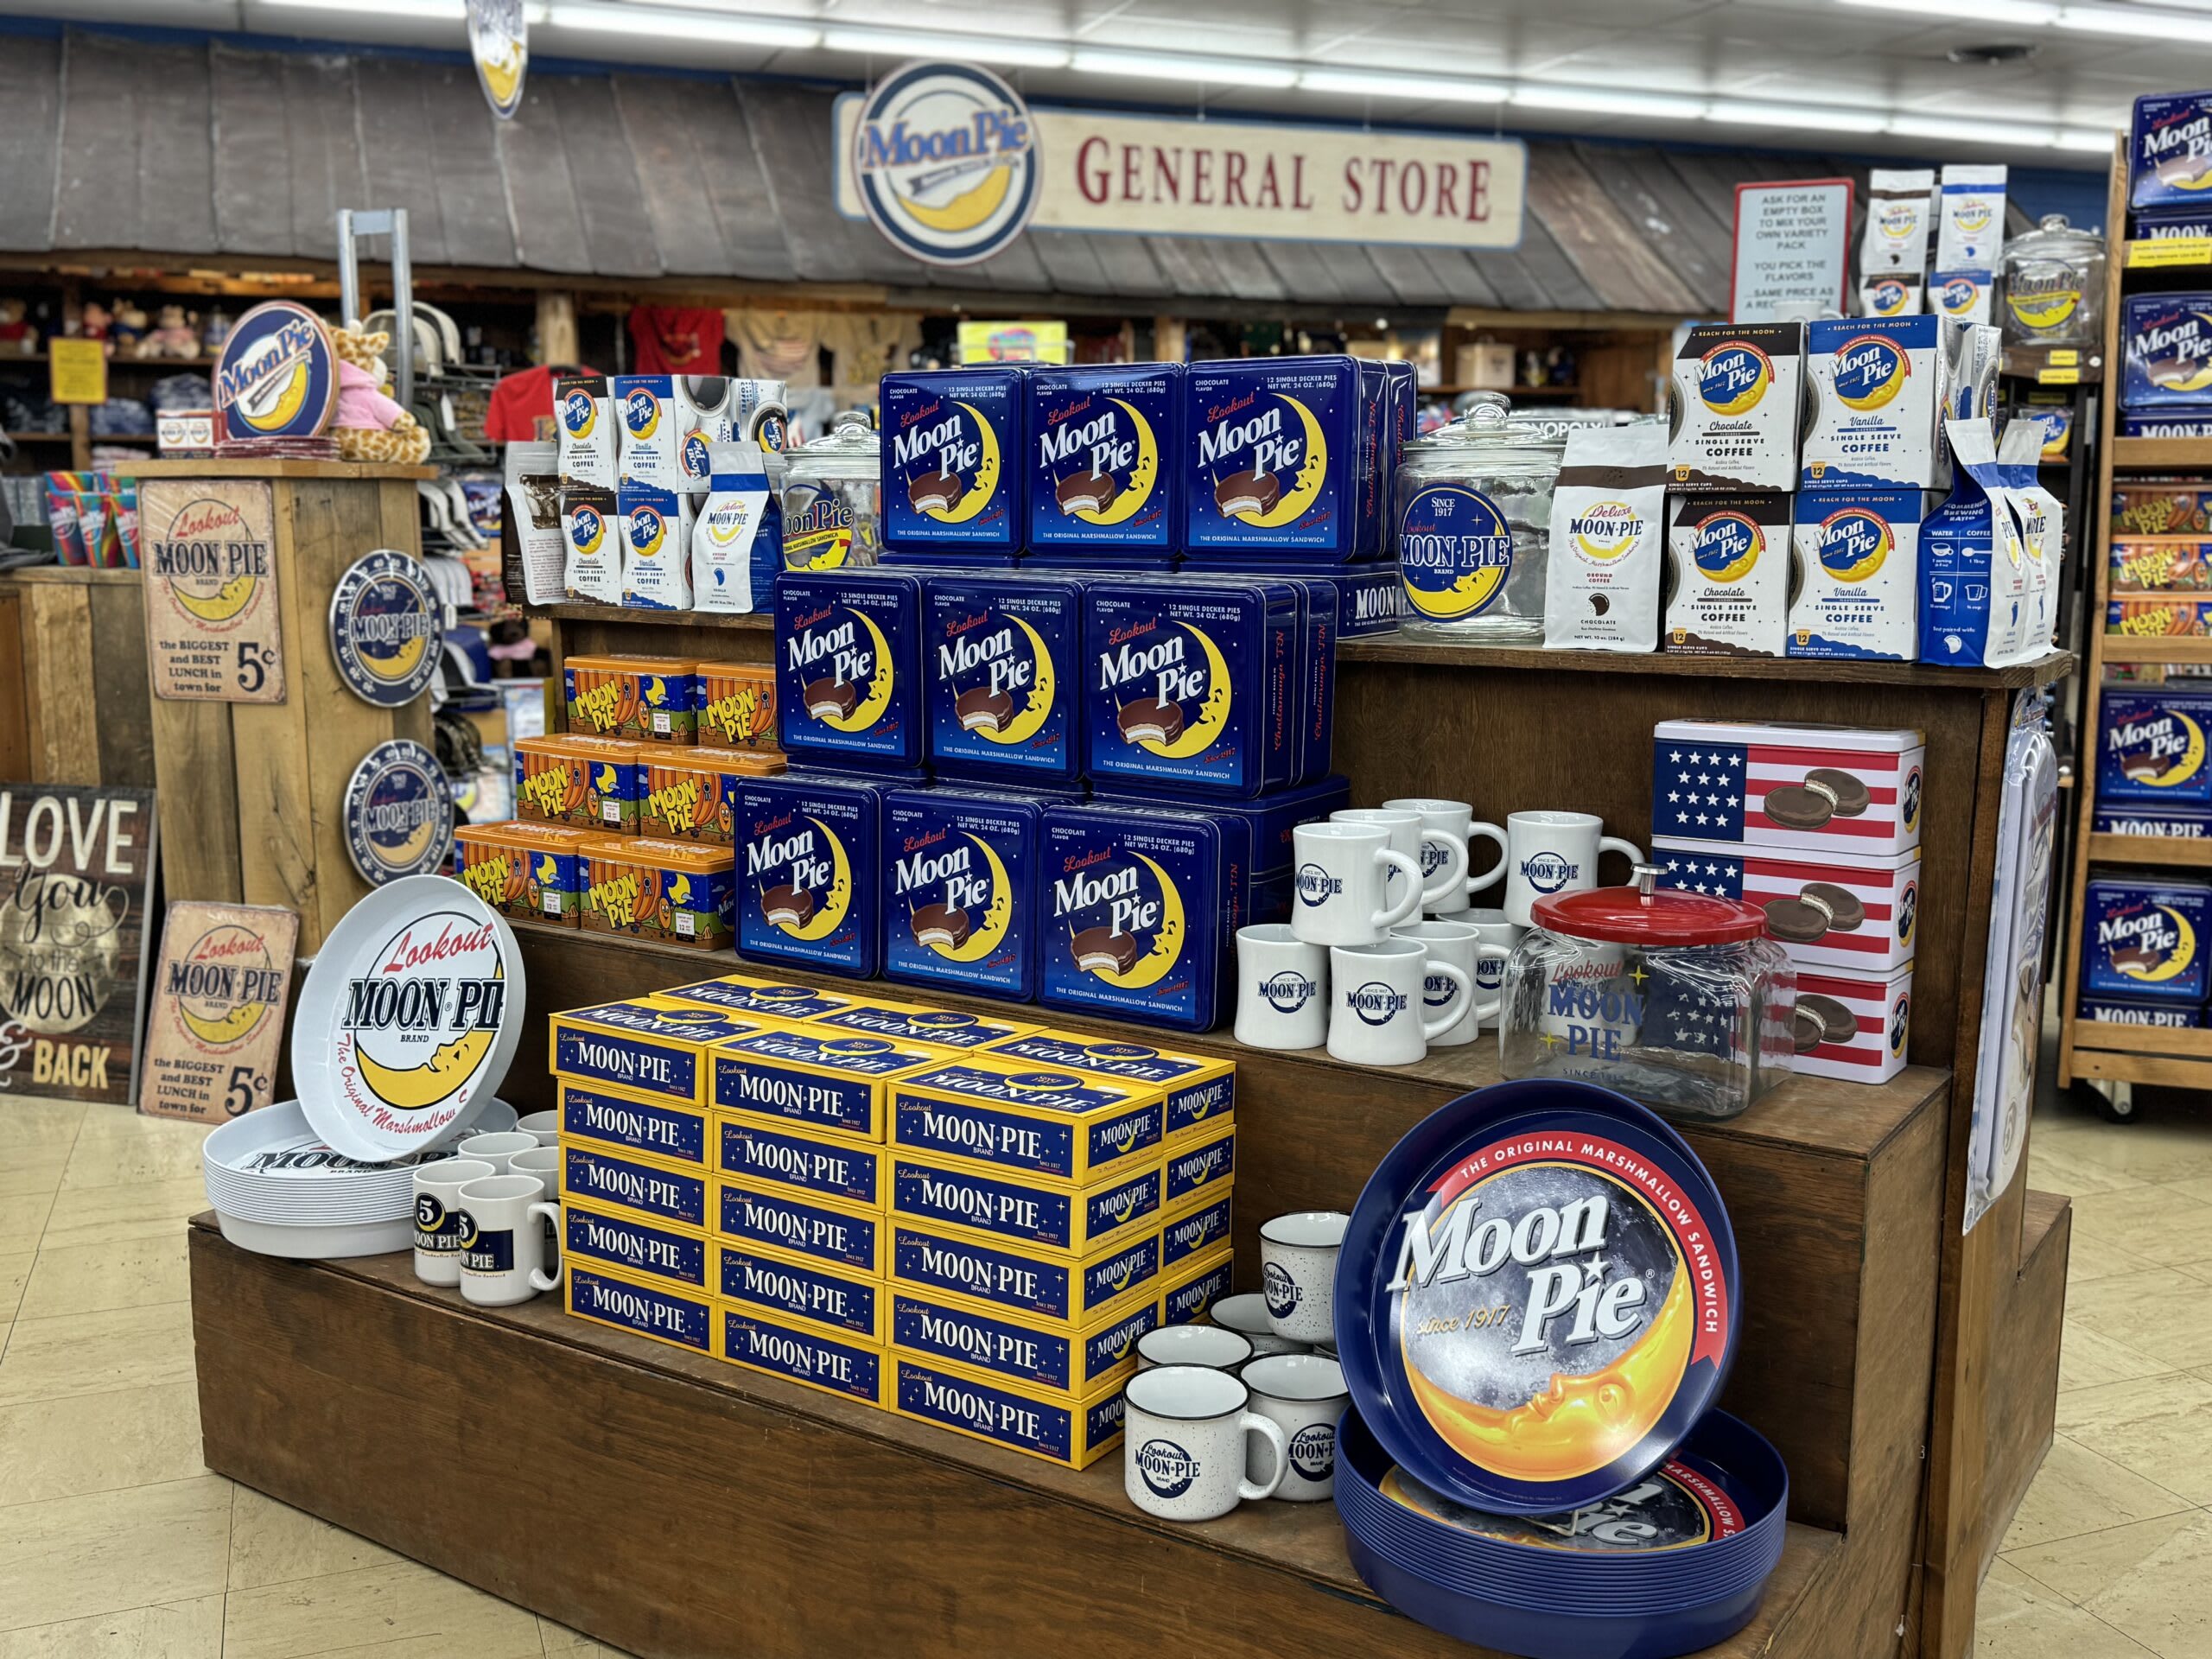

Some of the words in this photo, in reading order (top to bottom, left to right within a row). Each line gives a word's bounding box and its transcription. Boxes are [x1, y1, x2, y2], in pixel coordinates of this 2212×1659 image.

[1077, 135, 1315, 211] GENERAL
[1343, 156, 1492, 222] STORE
[1762, 195, 1783, 204] ASK
[1787, 194, 1808, 203] FOR
[1811, 194, 1826, 202] AN
[1764, 207, 1797, 216] EMPTY
[1801, 206, 1823, 214] BOX
[1756, 231, 1781, 240] OWN
[1783, 229, 1827, 238] VARIETY
[1764, 273, 1814, 282] FLAVORS
[1779, 261, 1802, 270] PICK
[1808, 260, 1826, 269] THE
[1786, 287, 1816, 296] PRICE
[1820, 287, 1834, 296] AS
[1828, 346, 1880, 381] Moon
[1861, 361, 1891, 386] Pie
[1709, 421, 1752, 431] Chocolate
[1849, 416, 1884, 427] Vanilla
[1039, 408, 1115, 468] Moon
[1198, 408, 1281, 469] Moon
[1841, 444, 1889, 453] COFFEE
[1090, 432, 1133, 480] Pie
[1253, 434, 1300, 482] Pie
[1706, 448, 1753, 457] COFFEE
[1677, 469, 1688, 479] 12
[1431, 497, 1455, 508] SINCE
[1434, 507, 1452, 517] 1917
[1588, 505, 1632, 518] Deluxe
[175, 505, 240, 538] Lookout
[1096, 600, 1130, 608] CHOCOLATE
[1109, 616, 1157, 645] Lookout
[159, 640, 176, 651] the
[179, 640, 230, 652] BIGGEST
[938, 628, 1014, 681] Moon
[169, 655, 190, 664] and
[194, 655, 220, 665] BEST
[1099, 636, 1185, 690] Moon
[168, 668, 207, 679] LUNCH
[210, 670, 222, 679] in
[989, 656, 1030, 698] Pie
[1156, 663, 1204, 709] Pie
[174, 682, 202, 693] town
[205, 682, 222, 692] for
[576, 680, 620, 718] MOON
[2108, 716, 2172, 751] Moon
[2151, 735, 2188, 760] Pie
[1116, 761, 1144, 770] ORIGINAL
[1146, 764, 1194, 776] MARSHMALLOW
[1196, 770, 1230, 779] SANDWICH
[0, 791, 138, 874] LOVE
[1052, 827, 1085, 836] CHOCOLATE
[1133, 835, 1155, 843] SINGLE
[1156, 837, 1179, 846] DECKER
[1064, 846, 1111, 872] Lookout
[1173, 845, 1194, 855] (680g)
[895, 845, 971, 895] Moon
[945, 873, 988, 915] Pie
[1053, 866, 1139, 918] Moon
[14, 867, 115, 943] You
[1109, 893, 1157, 939] Pie
[195, 933, 265, 960] Lookout
[383, 921, 493, 975] Lookout
[28, 952, 46, 971] to
[49, 949, 81, 974] the
[1552, 960, 1624, 982] Lookout
[9, 971, 98, 1020] MOON
[1068, 988, 1097, 998] ORIGINAL
[1098, 991, 1147, 1007] MARSHMALLOW
[1148, 1001, 1183, 1012] SANDWICH
[1548, 984, 1643, 1025] MOON
[338, 1033, 351, 1064] The
[1567, 1025, 1621, 1061] PIE
[33, 1039, 111, 1090] BACK
[154, 1059, 171, 1070] the
[173, 1059, 225, 1076] BIGGEST
[1563, 1068, 1595, 1078] SINCE
[156, 1085, 196, 1100] LUNCH
[199, 1090, 210, 1101] in
[160, 1073, 180, 1084] and
[181, 1075, 213, 1088] BEST
[341, 1066, 374, 1117] Original
[159, 1101, 187, 1113] town
[188, 1103, 207, 1115] for
[899, 1101, 931, 1113] Lookout
[973, 1147, 994, 1156] BRAND
[419, 1200, 434, 1223] 5
[1384, 1193, 1612, 1293] Moon
[1460, 1158, 1489, 1179] THE
[1494, 1140, 1573, 1161] ORIGINAL
[1581, 1143, 1692, 1226] MARSHMALLOW
[1688, 1231, 1719, 1334] SANDWICH
[1510, 1252, 1649, 1355] Pie
[1417, 1315, 1459, 1335] since
[1464, 1304, 1511, 1332] 1917
[1144, 1443, 1185, 1460] Lookout
